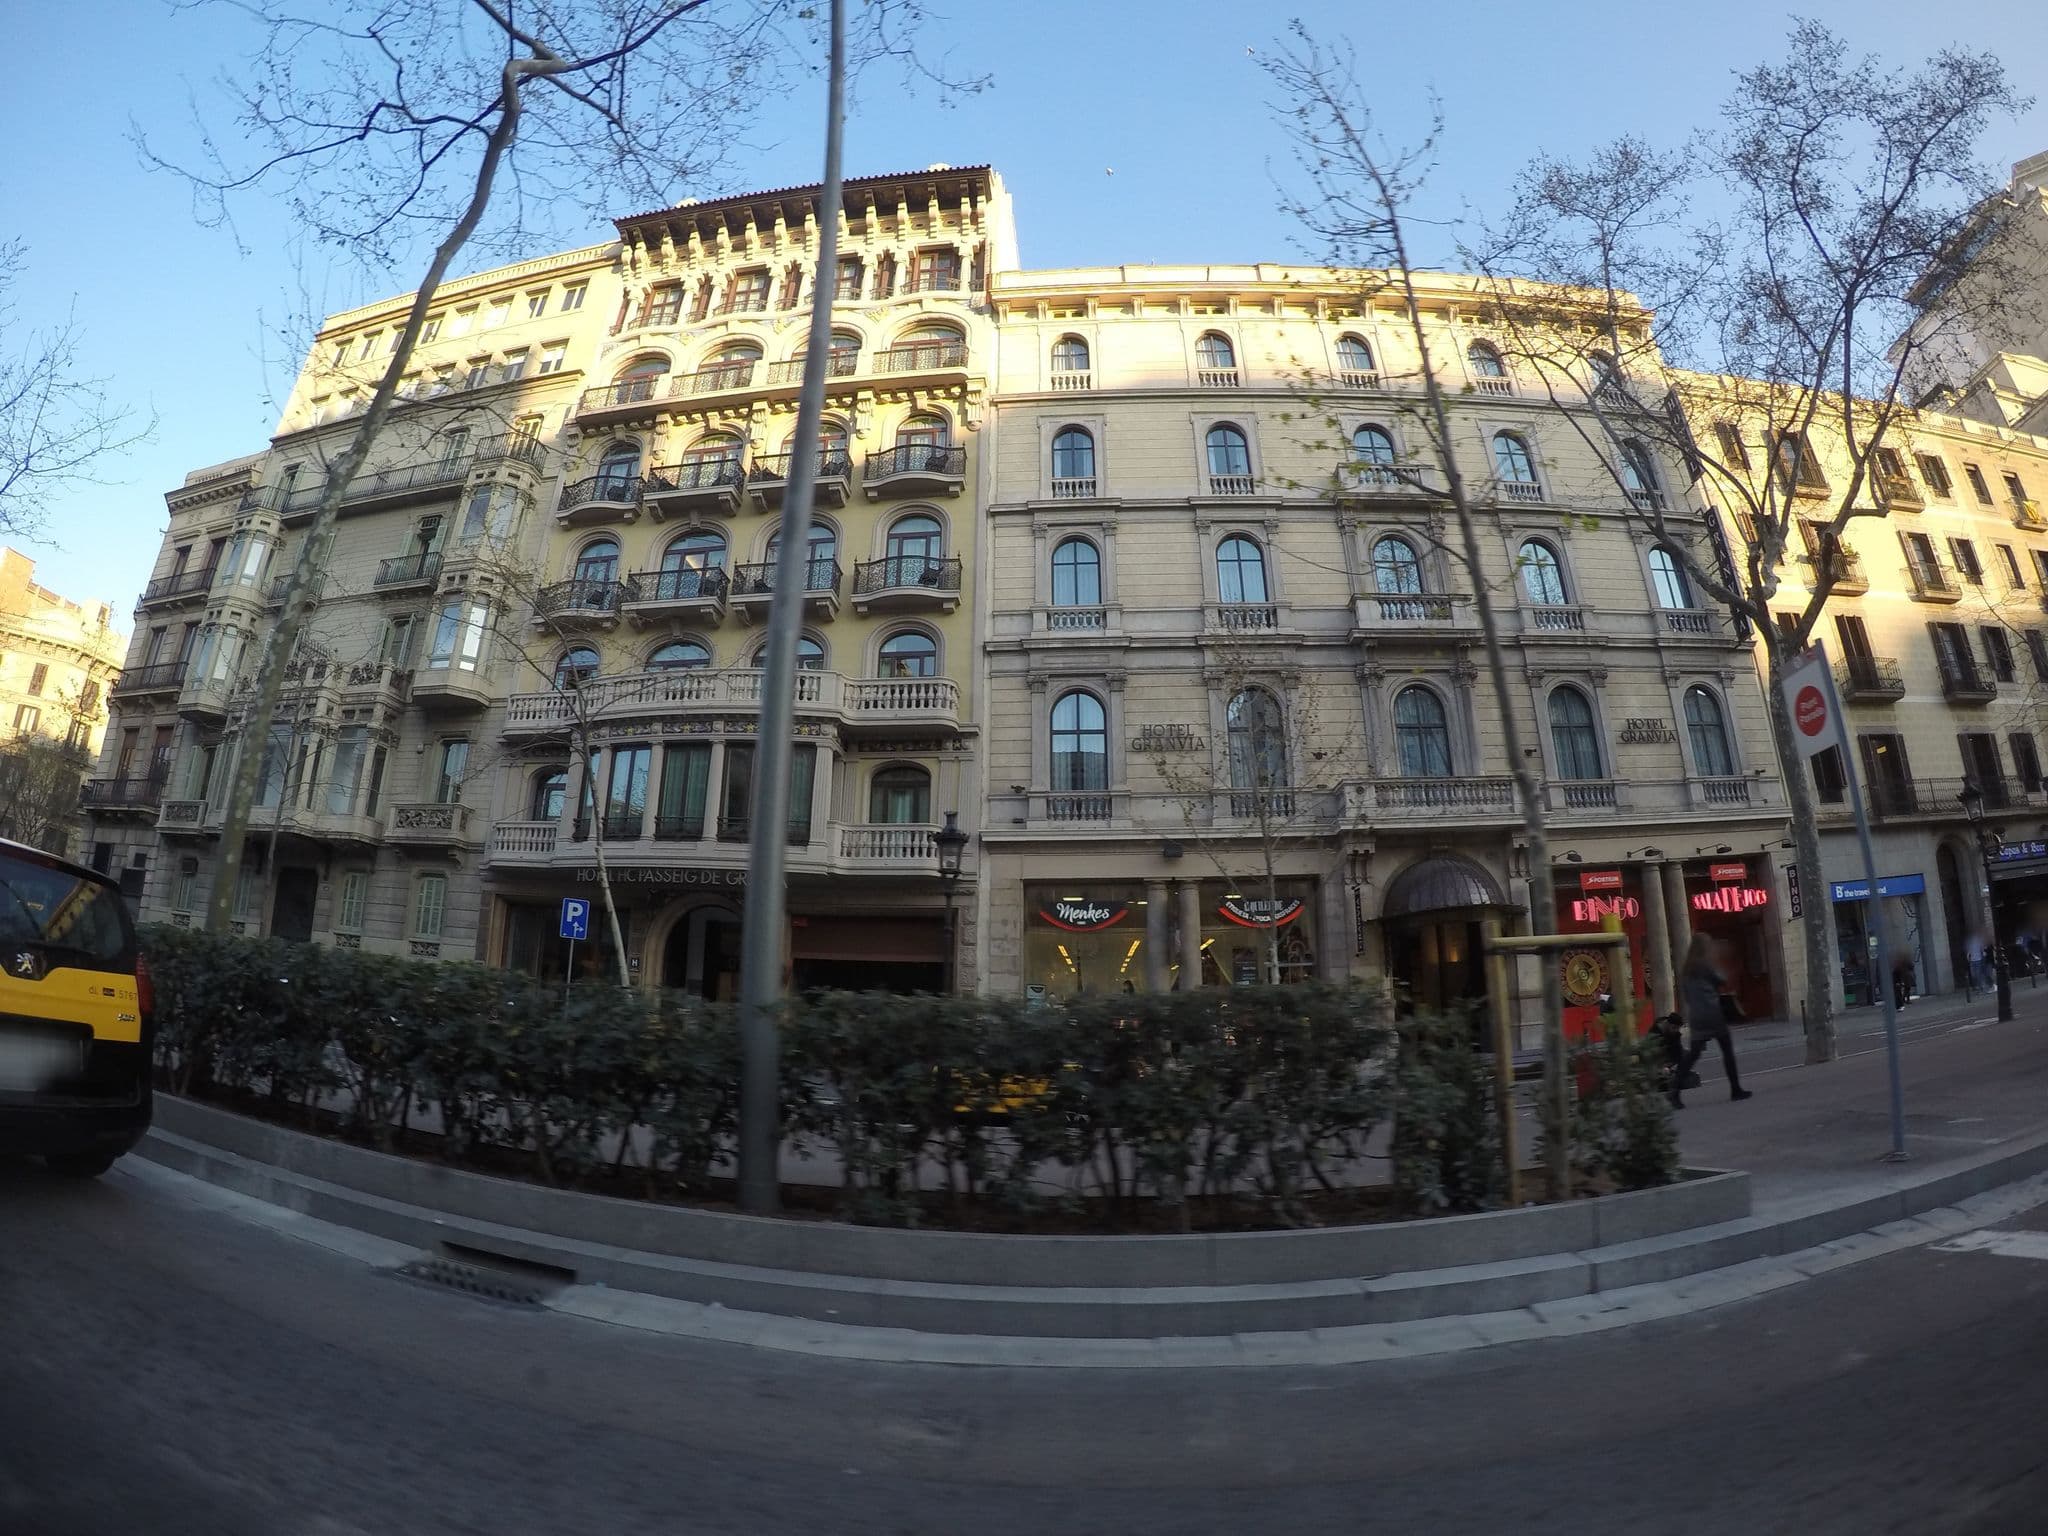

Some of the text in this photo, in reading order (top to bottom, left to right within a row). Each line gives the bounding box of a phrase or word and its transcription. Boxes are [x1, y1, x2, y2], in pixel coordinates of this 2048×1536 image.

[1143, 724, 1194, 736] HOTEL
[1626, 718, 1667, 729] HOTEL
[577, 868, 614, 882] HOTL
[638, 869, 696, 883] PASSEIG
[701, 871, 720, 884] DE
[1789, 869, 1800, 913] BINGO
[566, 902, 583, 922] P
[1056, 903, 1110, 923] Menkes
[1573, 895, 1639, 922] BINGO
